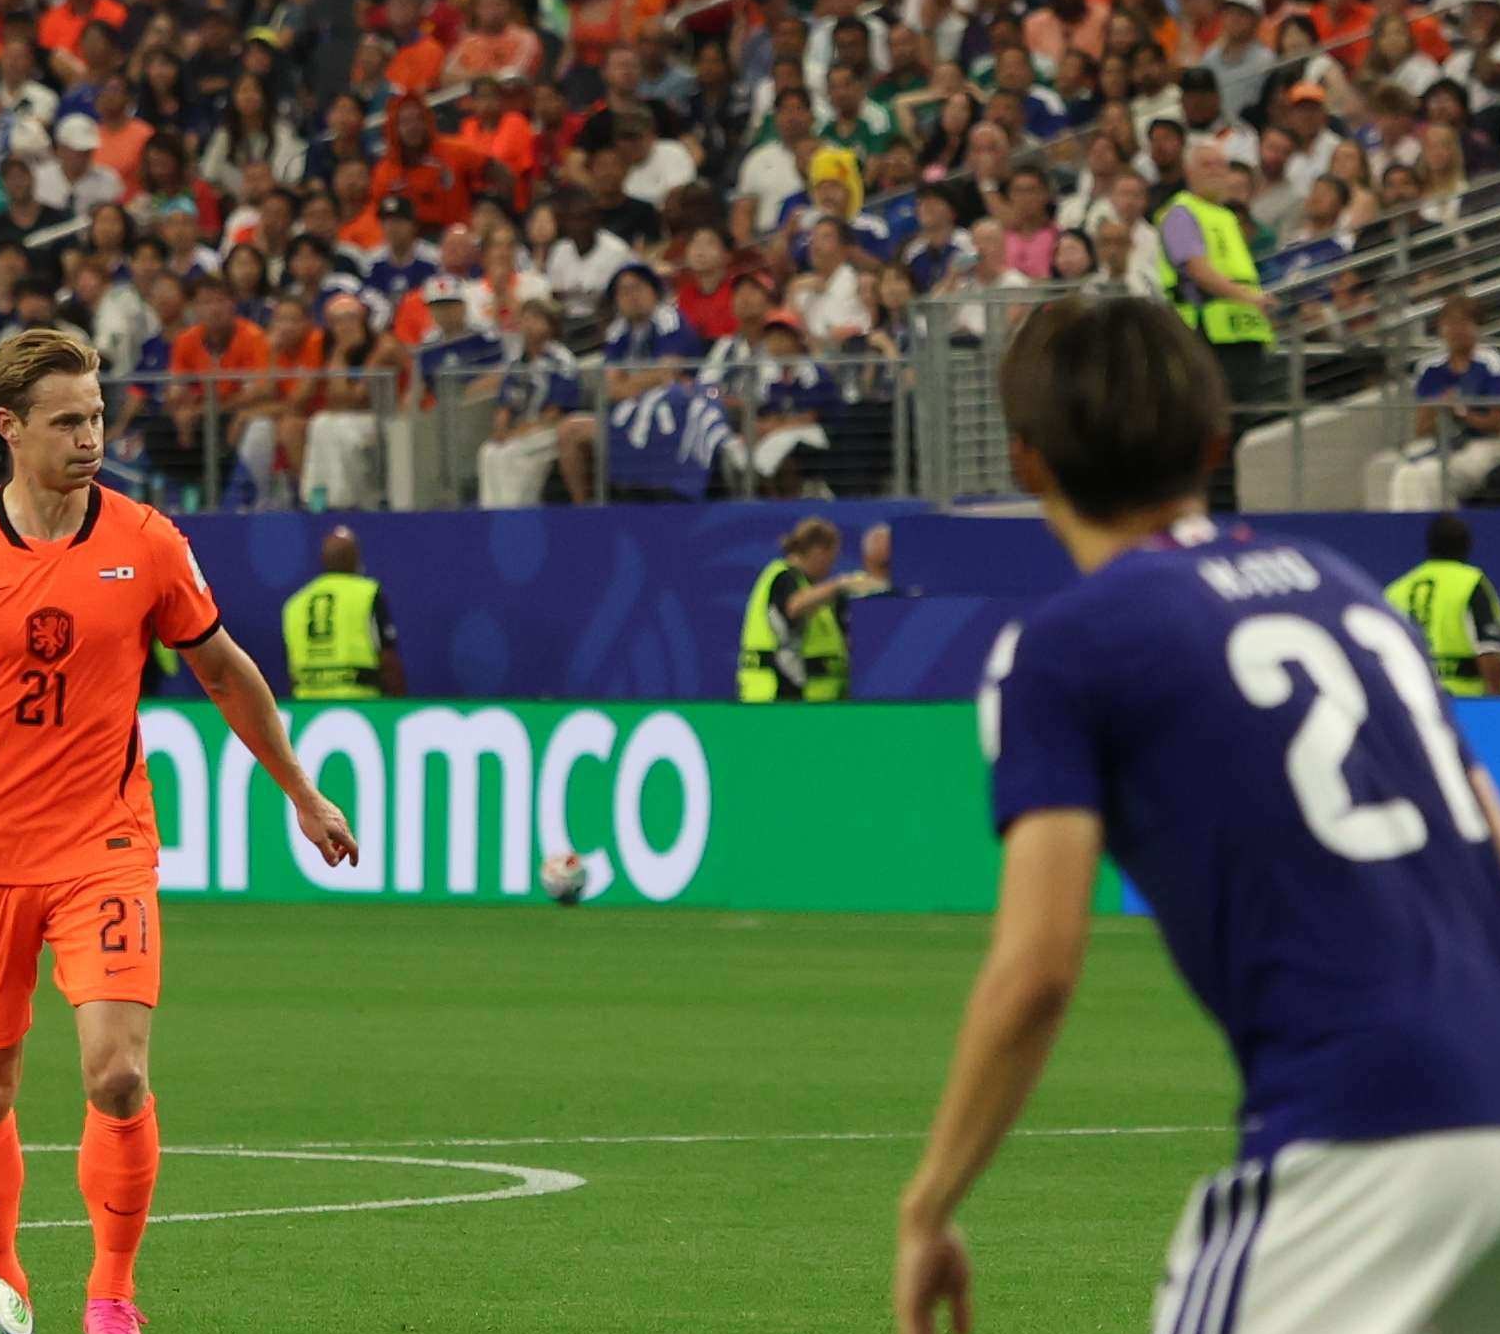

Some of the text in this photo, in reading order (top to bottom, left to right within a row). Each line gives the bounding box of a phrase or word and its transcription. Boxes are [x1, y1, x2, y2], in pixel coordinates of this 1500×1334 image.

[15, 669, 67, 727] 21
[1226, 604, 1491, 862] 21
[138, 708, 711, 902] aramco
[99, 896, 148, 955] 21
